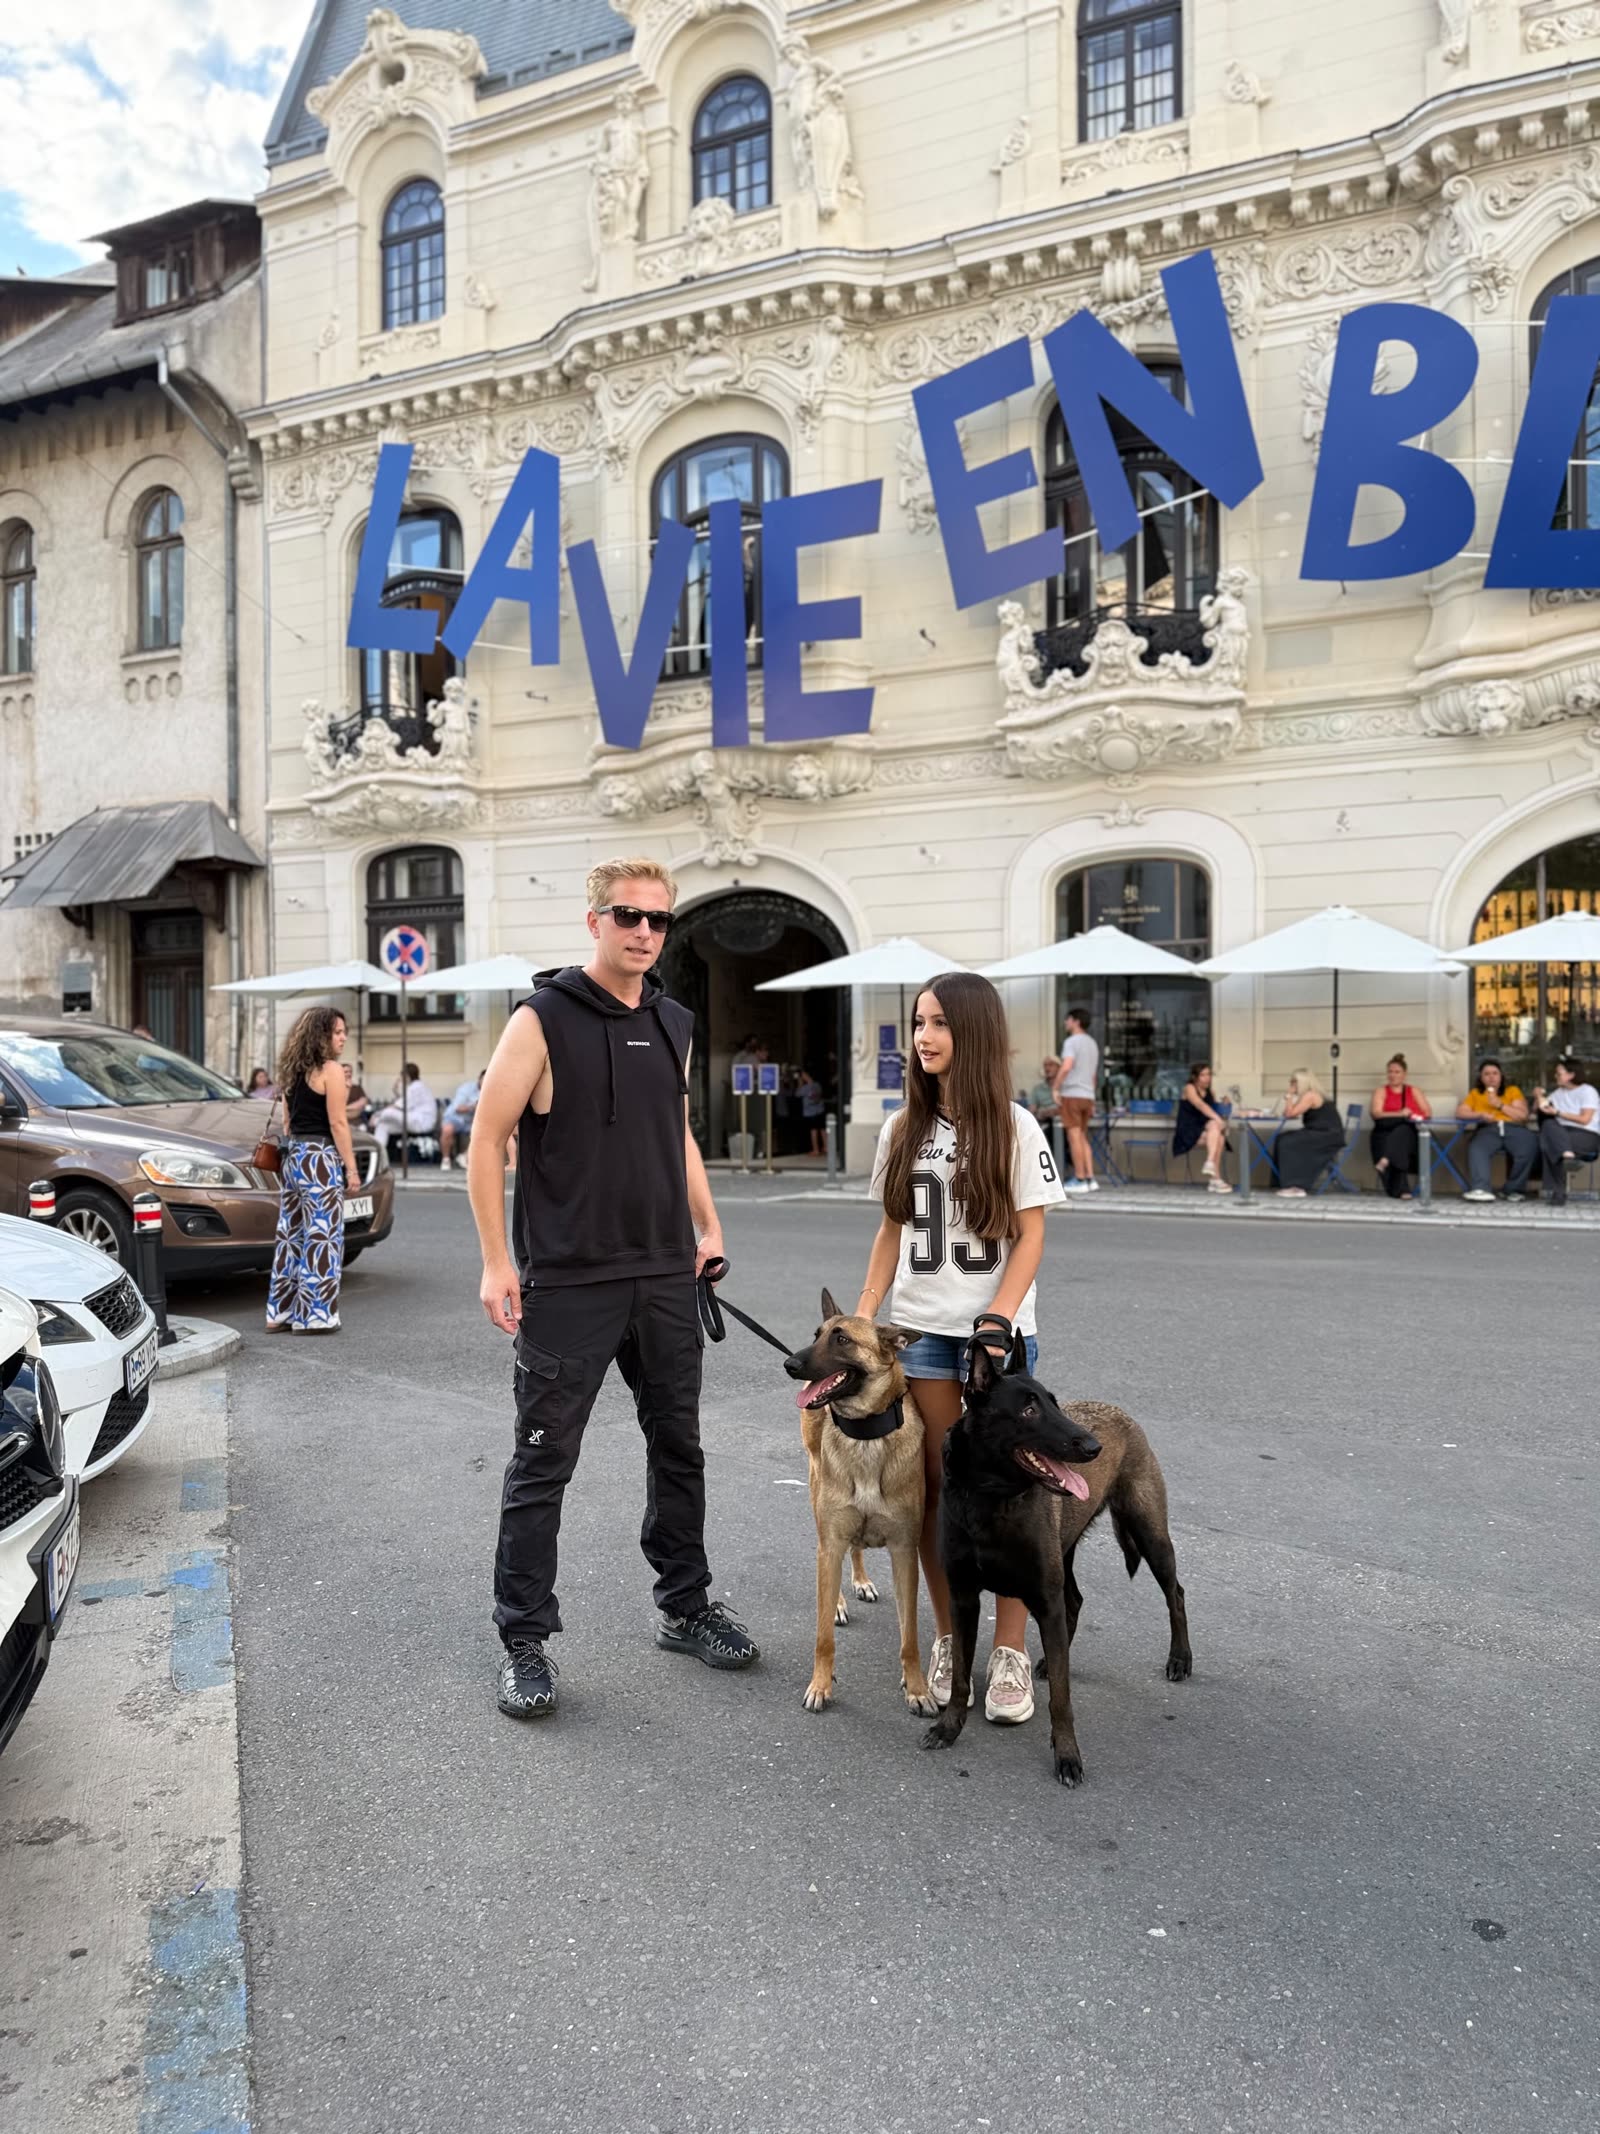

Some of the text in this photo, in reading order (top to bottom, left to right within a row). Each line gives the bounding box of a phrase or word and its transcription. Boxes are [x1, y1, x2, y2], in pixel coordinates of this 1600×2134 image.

[347, 442, 560, 666] LA
[566, 478, 884, 750] VIE
[911, 248, 1265, 611] EN
